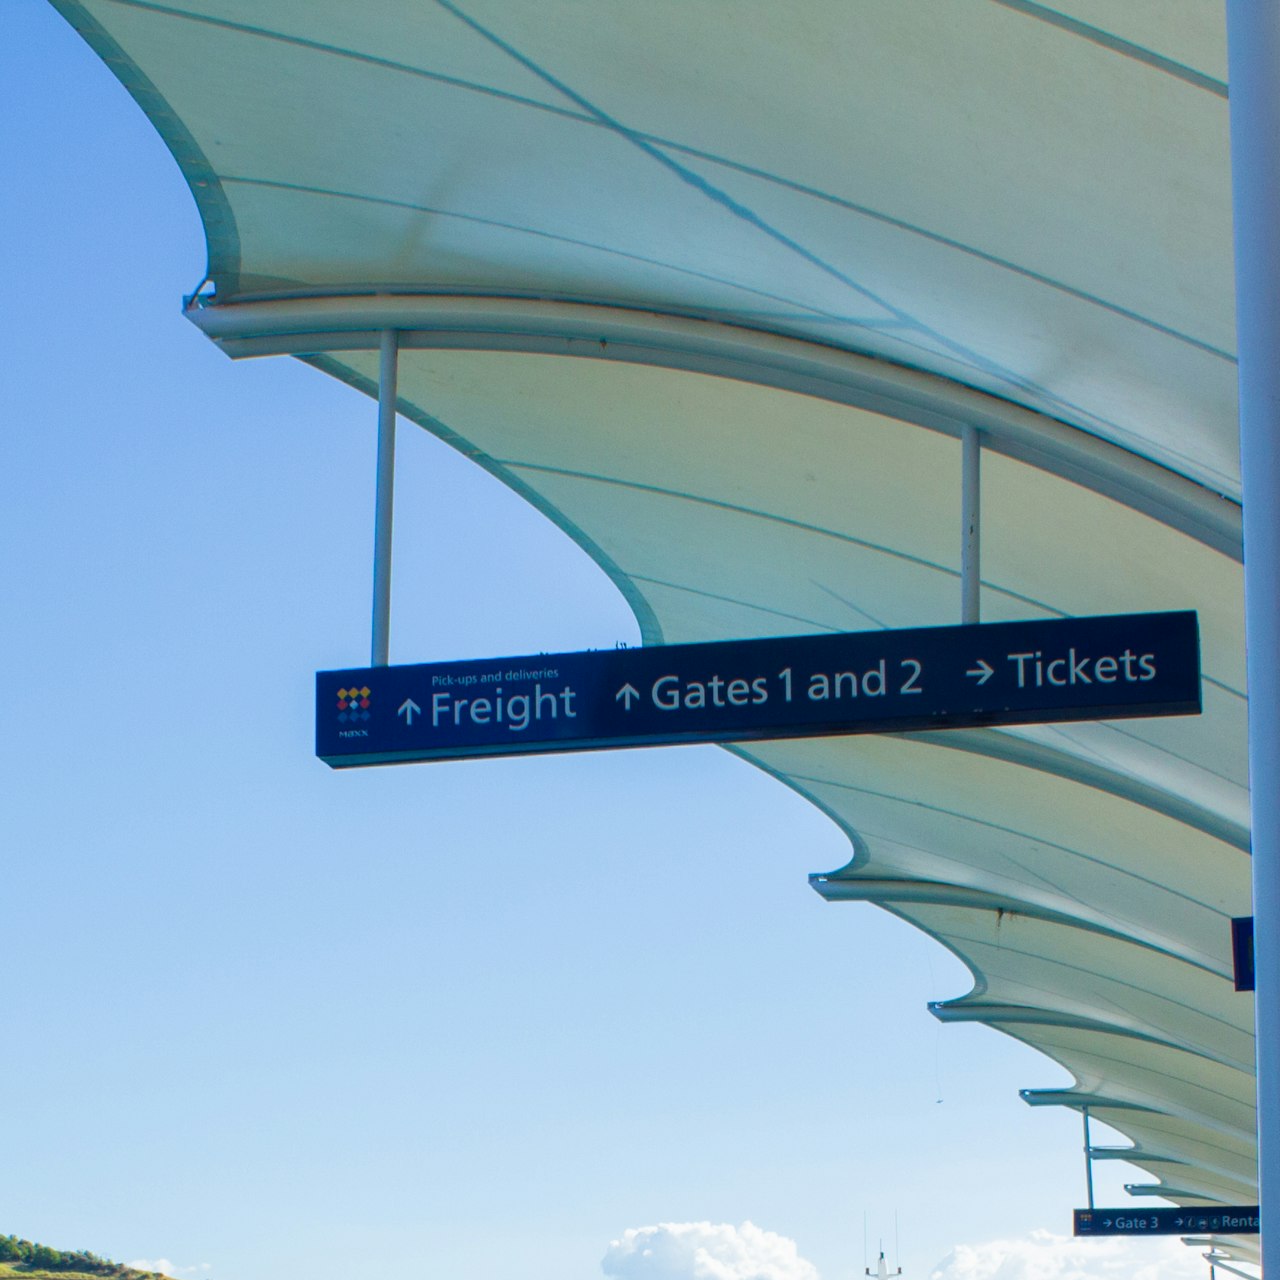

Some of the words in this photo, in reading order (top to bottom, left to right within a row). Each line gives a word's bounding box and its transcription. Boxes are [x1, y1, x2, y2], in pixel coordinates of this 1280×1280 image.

[431, 673, 478, 687] Pick-ups
[480, 671, 502, 684] and
[505, 668, 560, 682] deliveries
[651, 674, 769, 711] Gates
[778, 666, 793, 702] 1
[807, 658, 887, 700] and
[899, 658, 923, 695] 2
[1006, 647, 1157, 689] Tickets
[431, 683, 577, 730] Freight
[1114, 1216, 1147, 1230] Gate
[1149, 1216, 1160, 1229] 3
